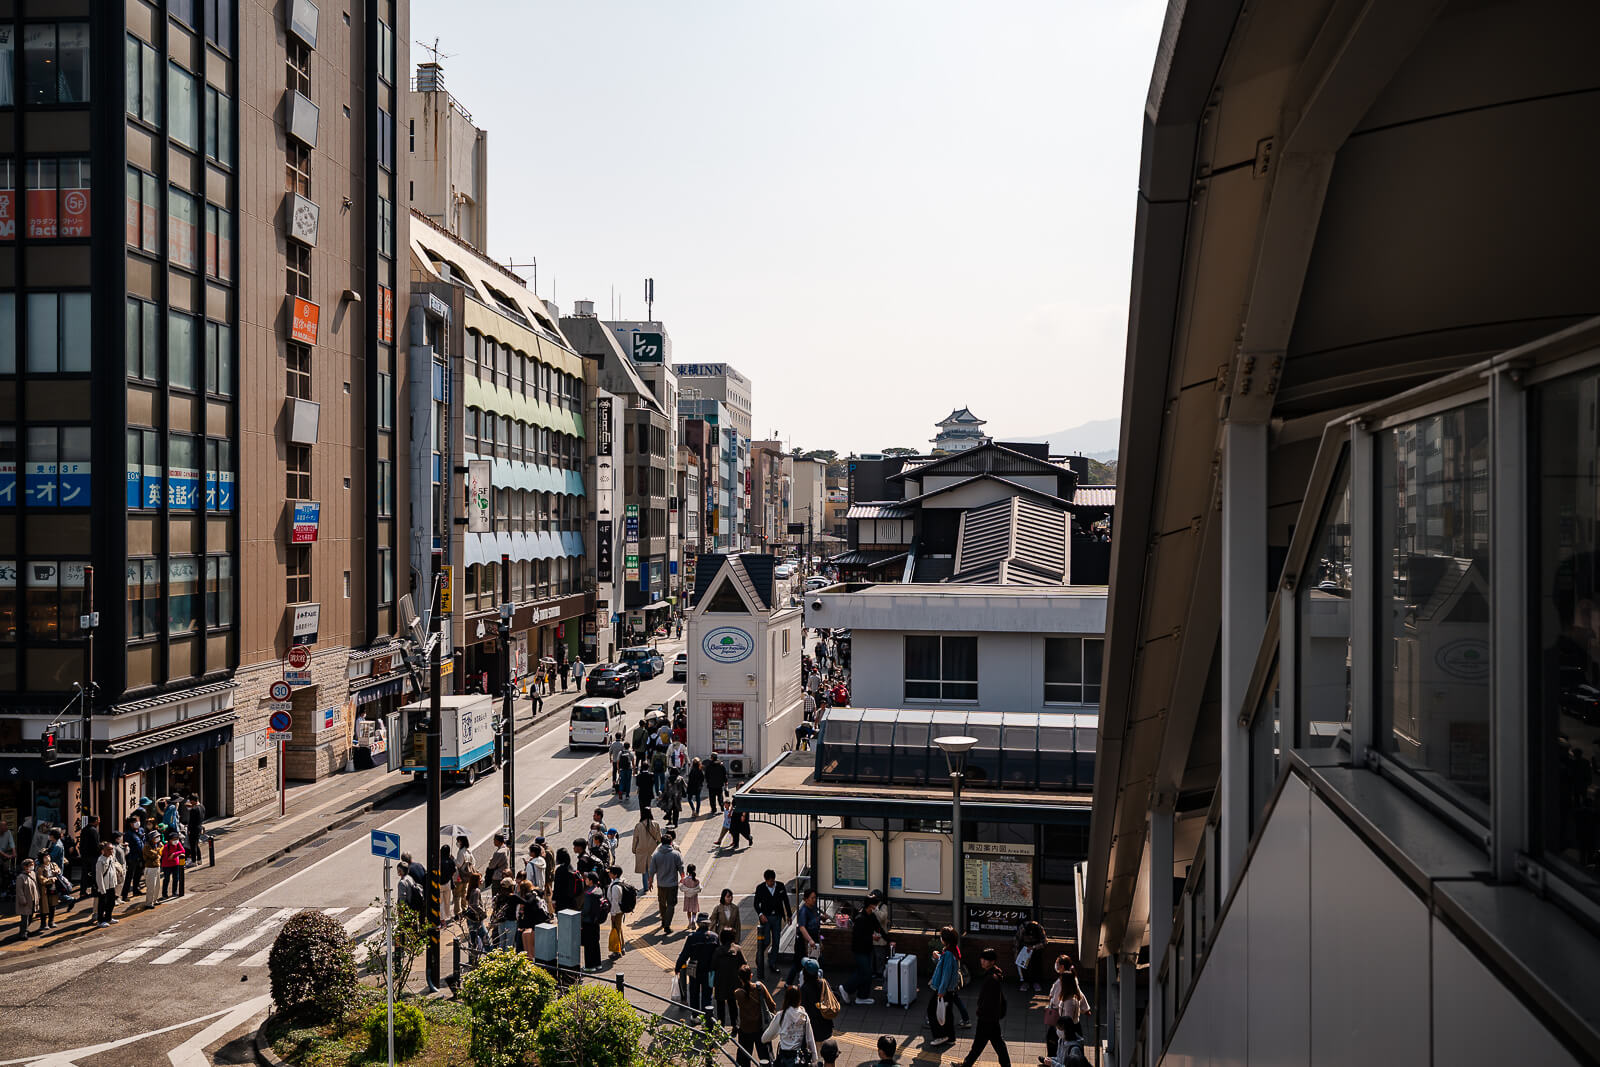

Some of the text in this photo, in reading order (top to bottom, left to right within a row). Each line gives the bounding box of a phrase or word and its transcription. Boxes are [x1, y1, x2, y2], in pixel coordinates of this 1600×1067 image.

[69, 197, 83, 209] 5F
[31, 225, 83, 236] factory
[635, 346, 657, 356] イク
[677, 365, 722, 377] 東横INN
[62, 465, 78, 473] 3F
[289, 654, 307, 662] 消火栓
[274, 686, 287, 697] 30
[968, 843, 1007, 853] 周辺案内図
[970, 909, 1027, 919] レンタサイクル
